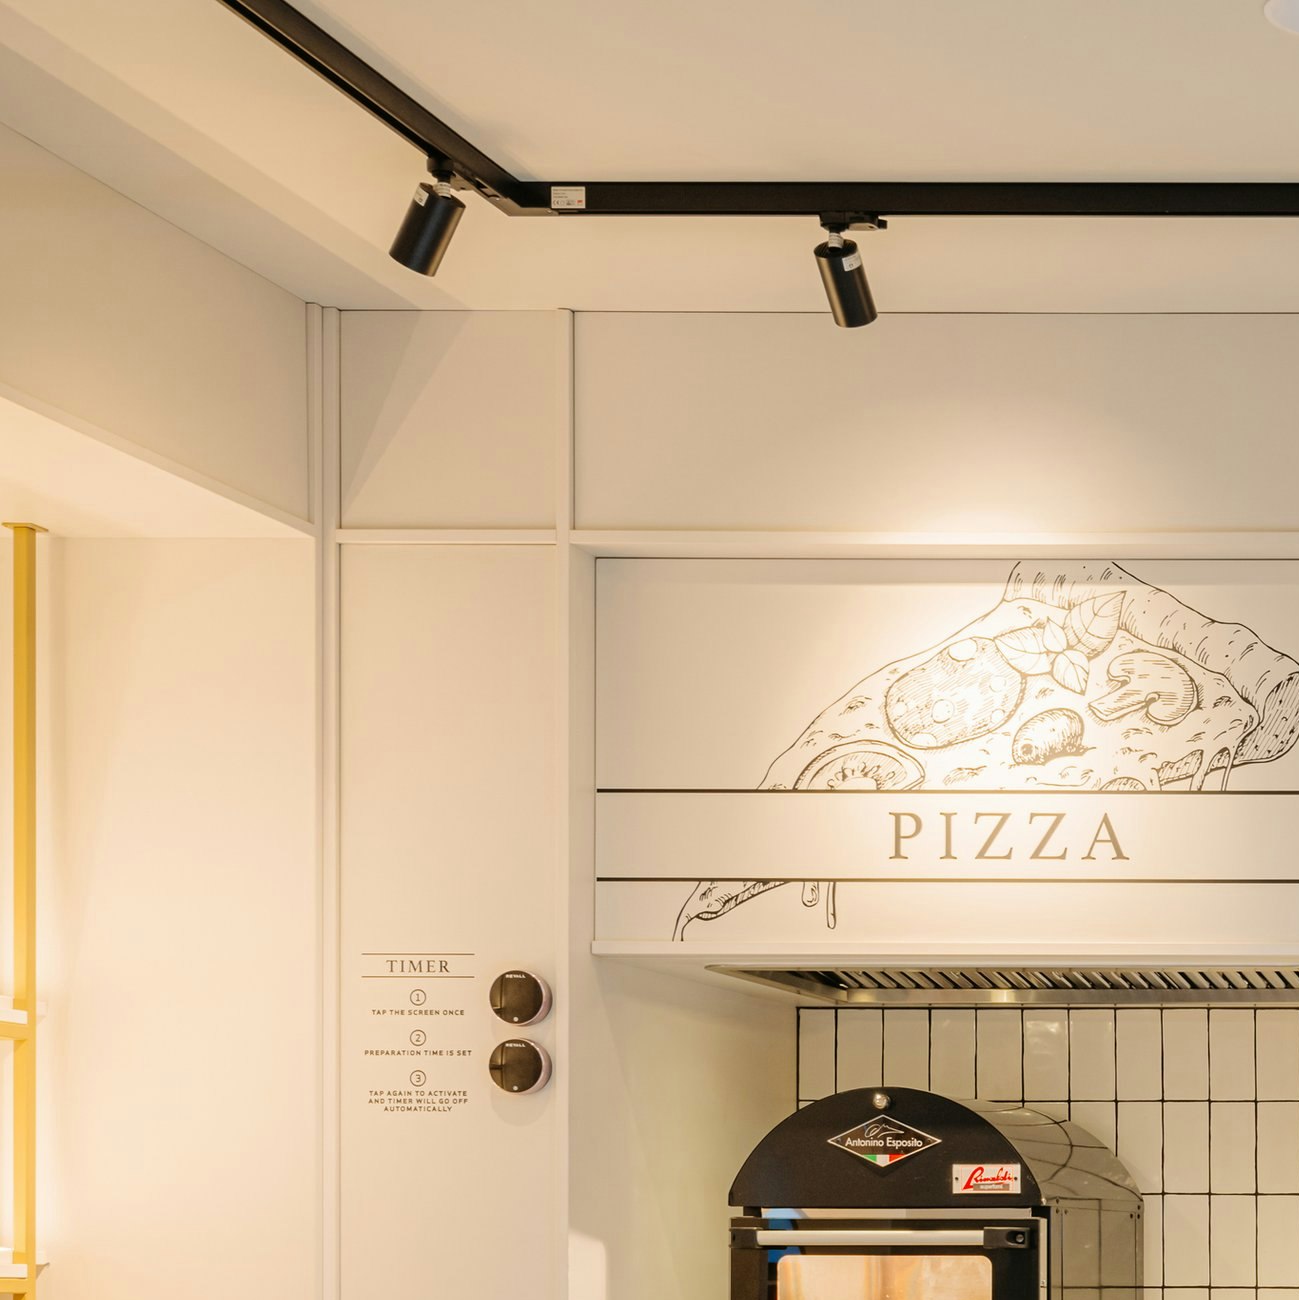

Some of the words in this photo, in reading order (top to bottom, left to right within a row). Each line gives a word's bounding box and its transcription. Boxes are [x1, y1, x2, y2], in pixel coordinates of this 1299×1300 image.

[889, 812, 1130, 860] PIZZA
[386, 959, 450, 973] TIMER
[415, 993, 421, 1002] 1
[415, 1033, 421, 1042] 2
[446, 1049, 454, 1057] IS
[456, 1049, 472, 1057] SET
[415, 1074, 421, 1082] 3
[845, 1136, 884, 1147] Antonino
[887, 1136, 923, 1150] Esposito
